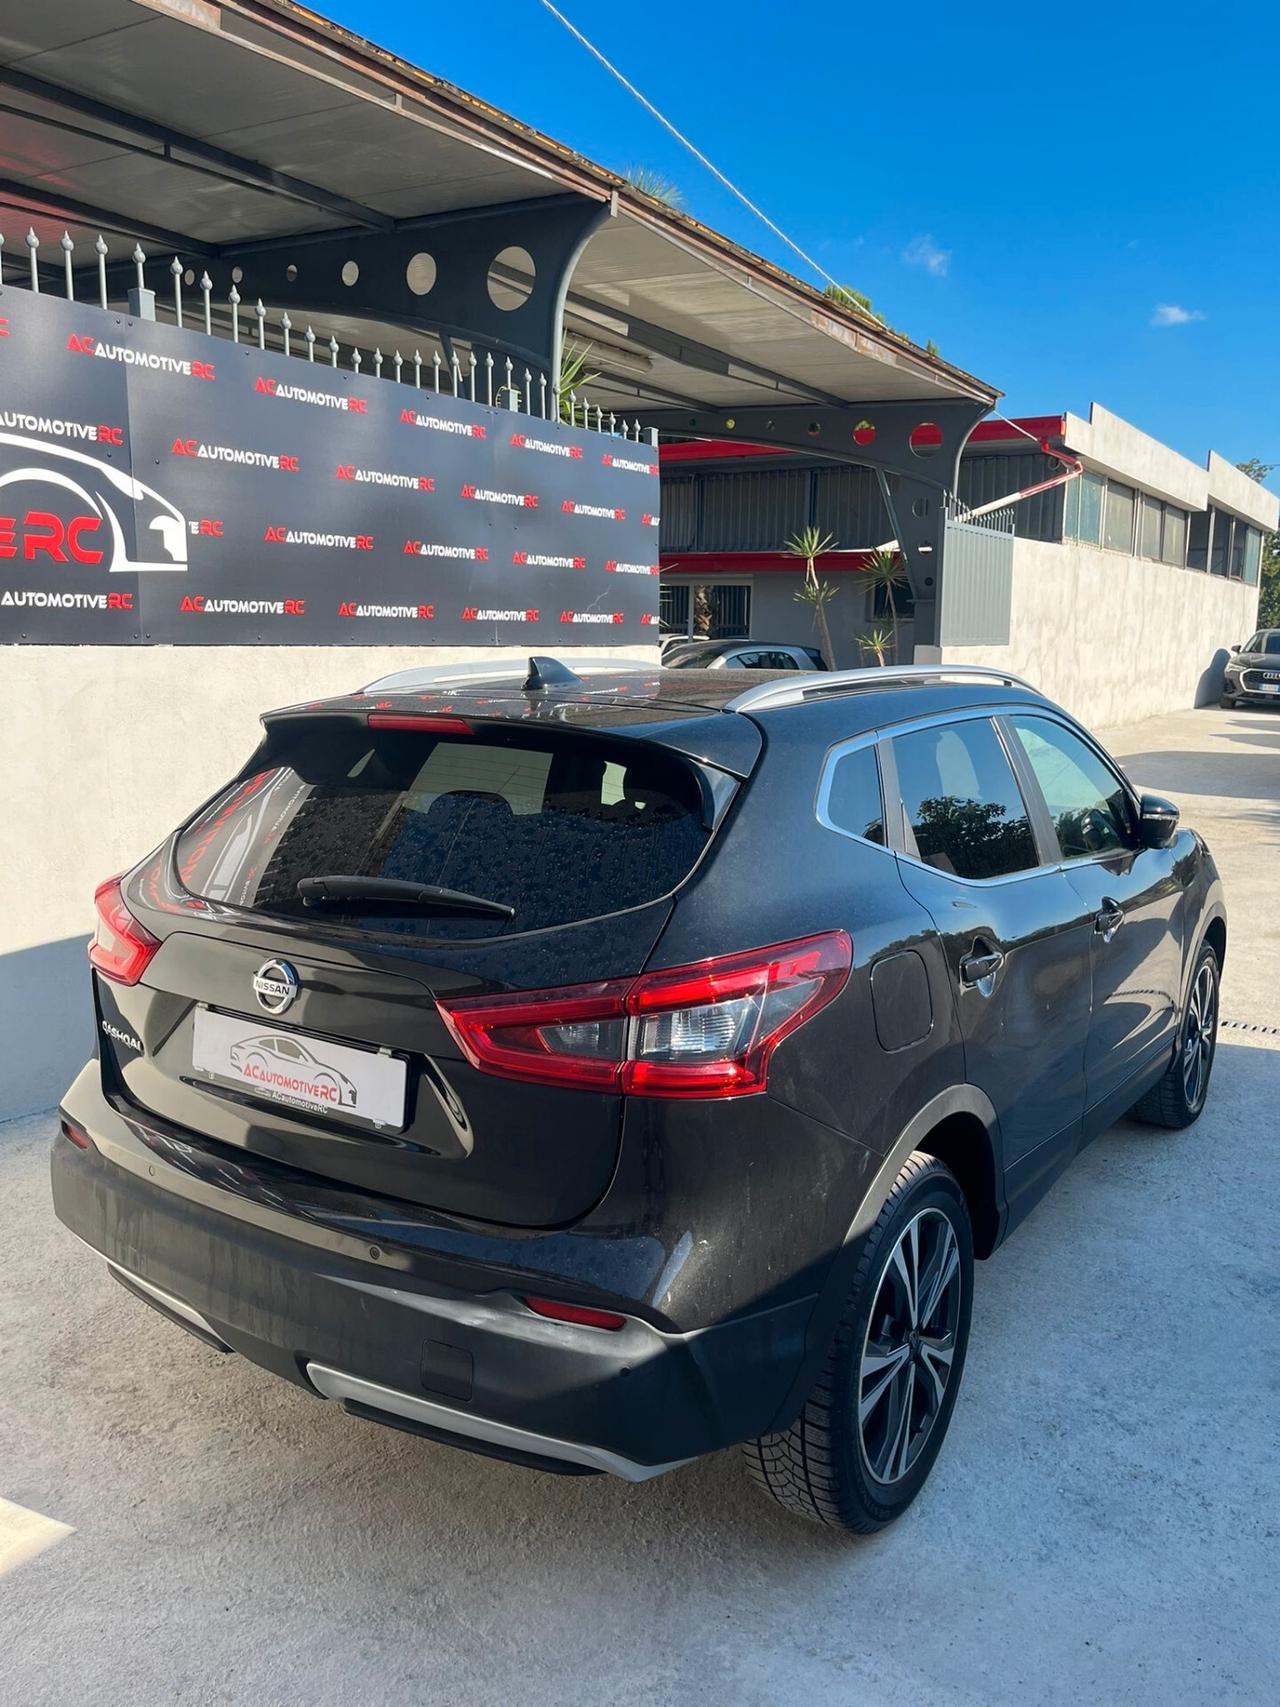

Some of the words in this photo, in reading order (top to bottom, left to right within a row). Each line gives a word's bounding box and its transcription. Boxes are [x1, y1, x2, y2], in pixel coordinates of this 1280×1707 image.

[66, 333, 215, 382] ACAUTOMOTIVERC
[254, 376, 368, 414] ACAUTOMOTIVERC
[400, 408, 487, 441] ACAUTOMOTIVERC
[171, 438, 300, 473] ACAUTOMOTIVERC
[335, 464, 435, 492] ACAUTOMOTIVERC
[188, 519, 225, 538] ERC
[264, 527, 374, 553] ACAUTOMOTIVERC
[403, 540, 489, 561] ACAUTOMOTIVERC
[180, 595, 305, 616] ACAUTOMOTIVERC
[337, 601, 435, 619] ACAUTOMOTIVERC
[255, 979, 290, 996] NISSAN
[102, 1020, 142, 1051] QASHQAI
[271, 1090, 329, 1115] ACautomotiveRC
